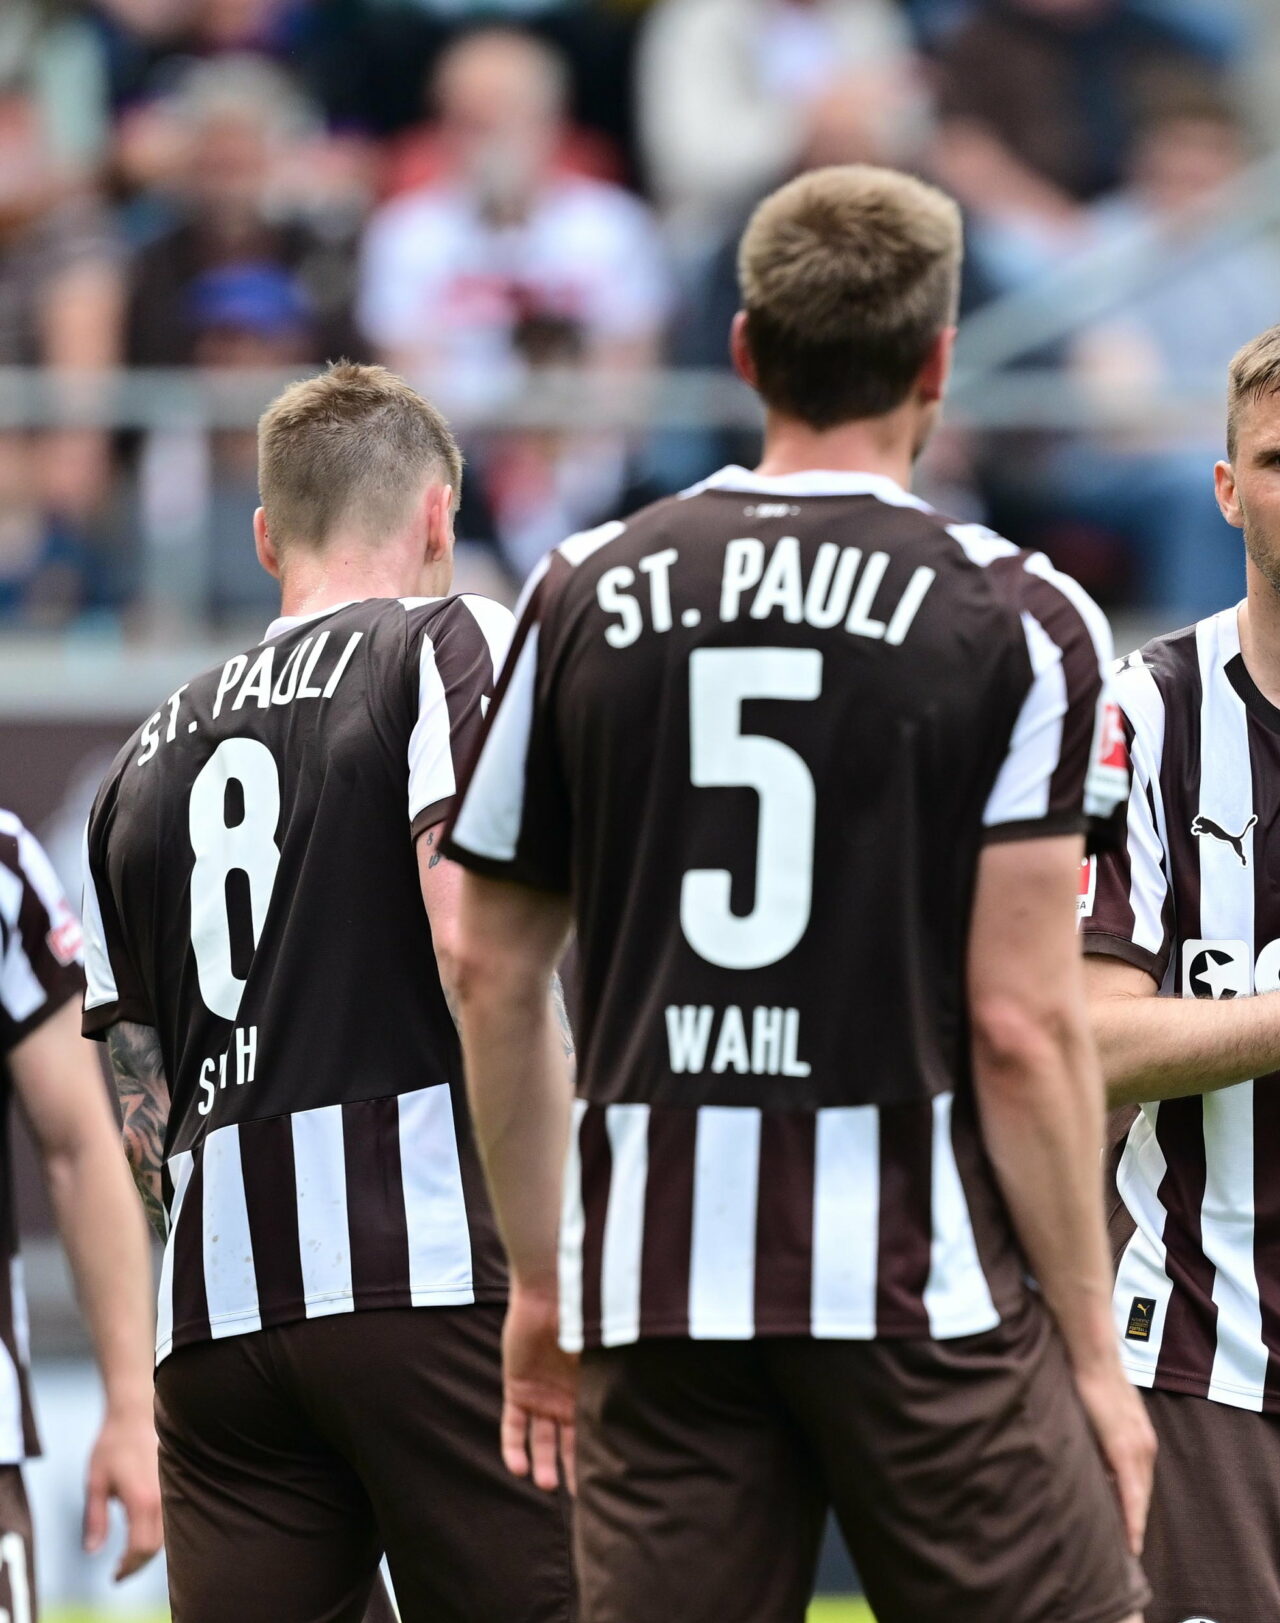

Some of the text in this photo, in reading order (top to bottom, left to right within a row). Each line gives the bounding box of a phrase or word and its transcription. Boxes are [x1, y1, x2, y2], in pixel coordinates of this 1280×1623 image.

[597, 537, 936, 648] ST. PAULI
[137, 631, 363, 766] ST. PAULI
[680, 647, 822, 969] 5
[188, 737, 281, 1021] 8
[665, 1006, 811, 1077] WAHL
